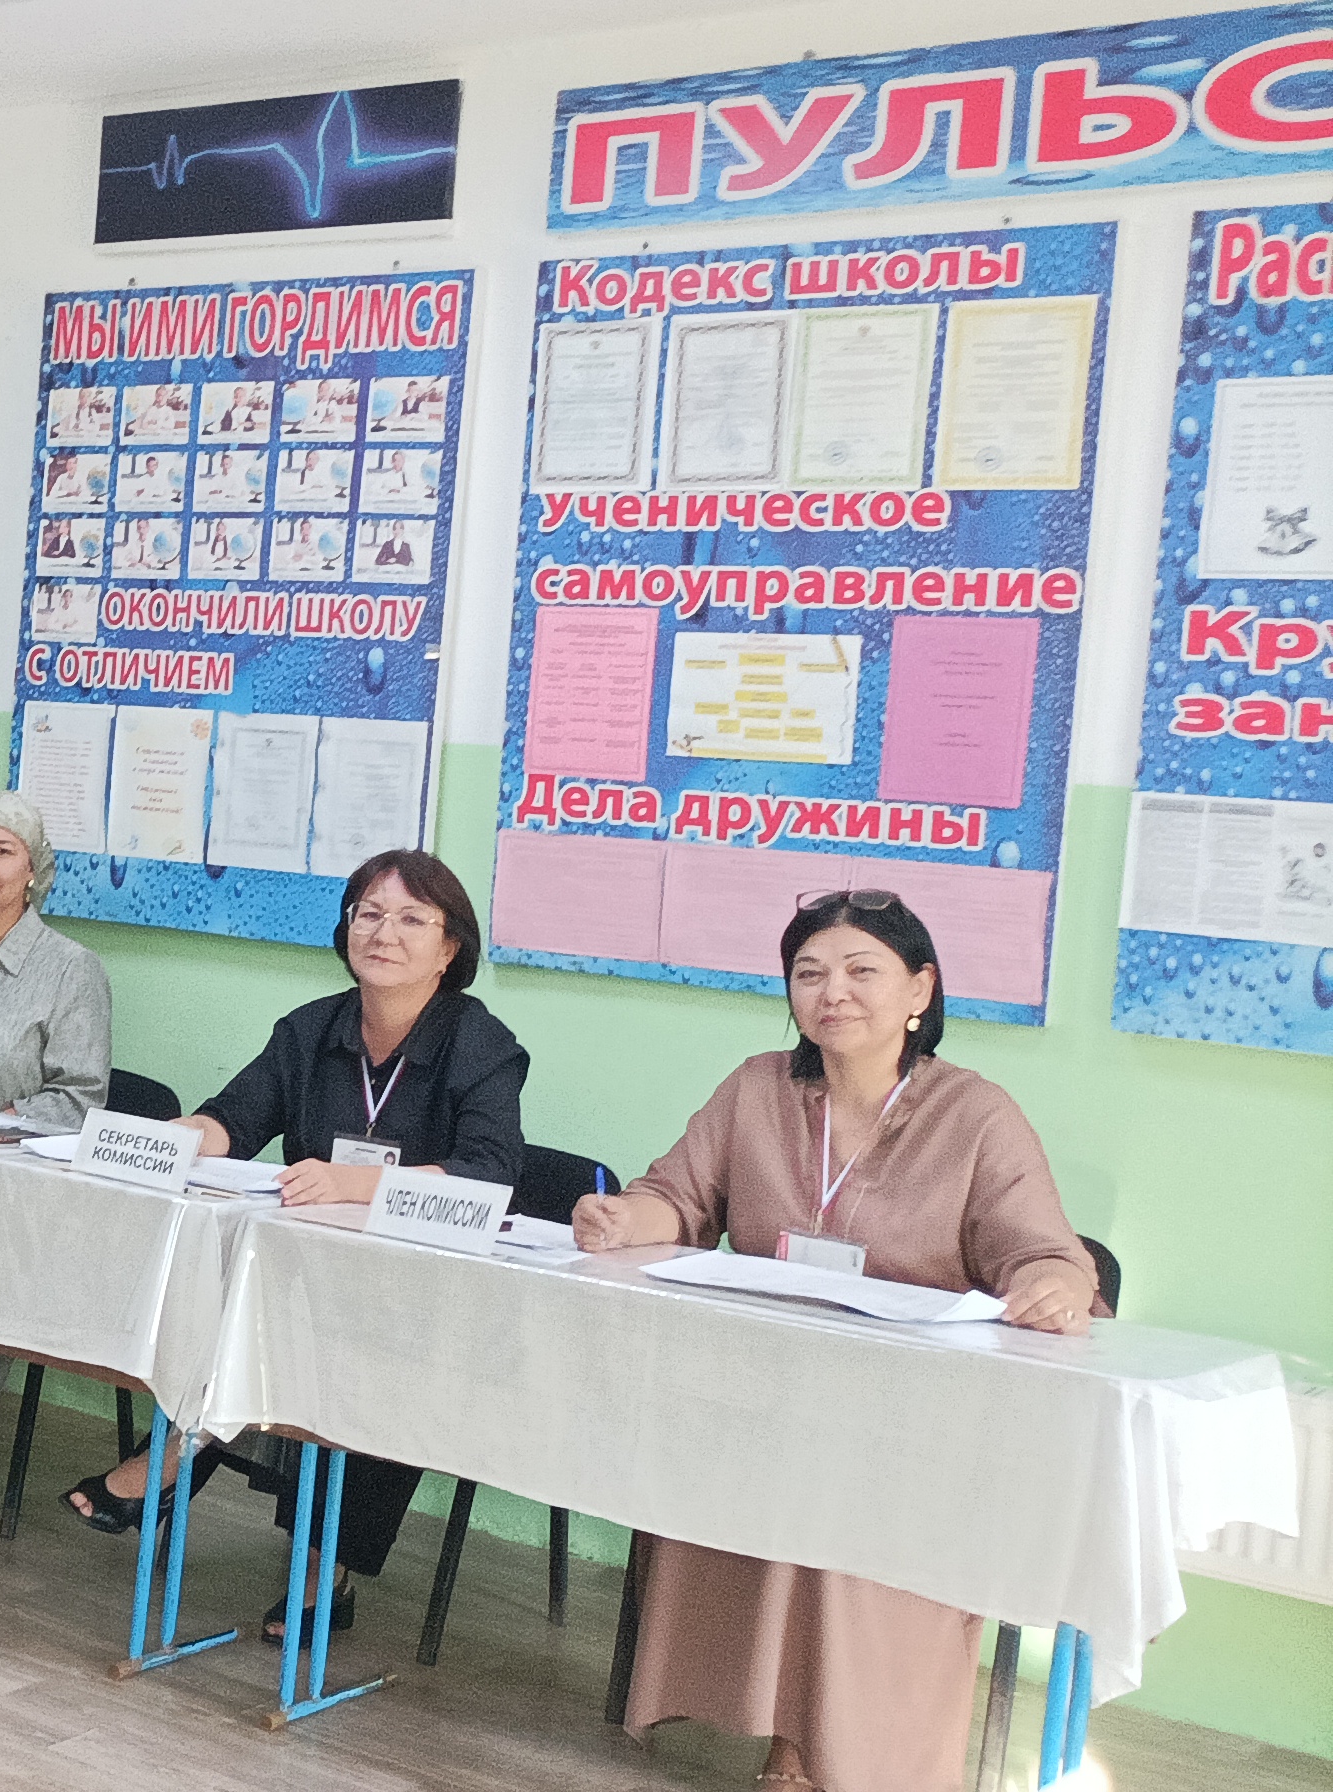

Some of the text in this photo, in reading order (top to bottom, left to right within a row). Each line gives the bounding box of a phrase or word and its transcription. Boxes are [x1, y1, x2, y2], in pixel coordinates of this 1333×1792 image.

[569, 38, 1333, 206] ПУЛЬС
[557, 246, 1023, 315] Кодекс школы
[1214, 222, 1333, 300] Рас
[51, 283, 460, 368] МЫ ИМИ ГОРДИМСЯ
[541, 491, 946, 530] Ученическое
[103, 590, 424, 638] ОКОНЧИЛИ ШКОЛУ
[533, 567, 1079, 617] самоуправление
[1185, 609, 1333, 671] Кр
[27, 646, 231, 692] С ОТЛИЧИЕМ
[516, 773, 981, 847] Дела дружины
[92, 1145, 175, 1175] КОМИССИИ
[98, 1128, 178, 1157] СЕКРЕТАРЬ
[385, 1187, 493, 1231] ЧЛЕН КОМИССИИ
